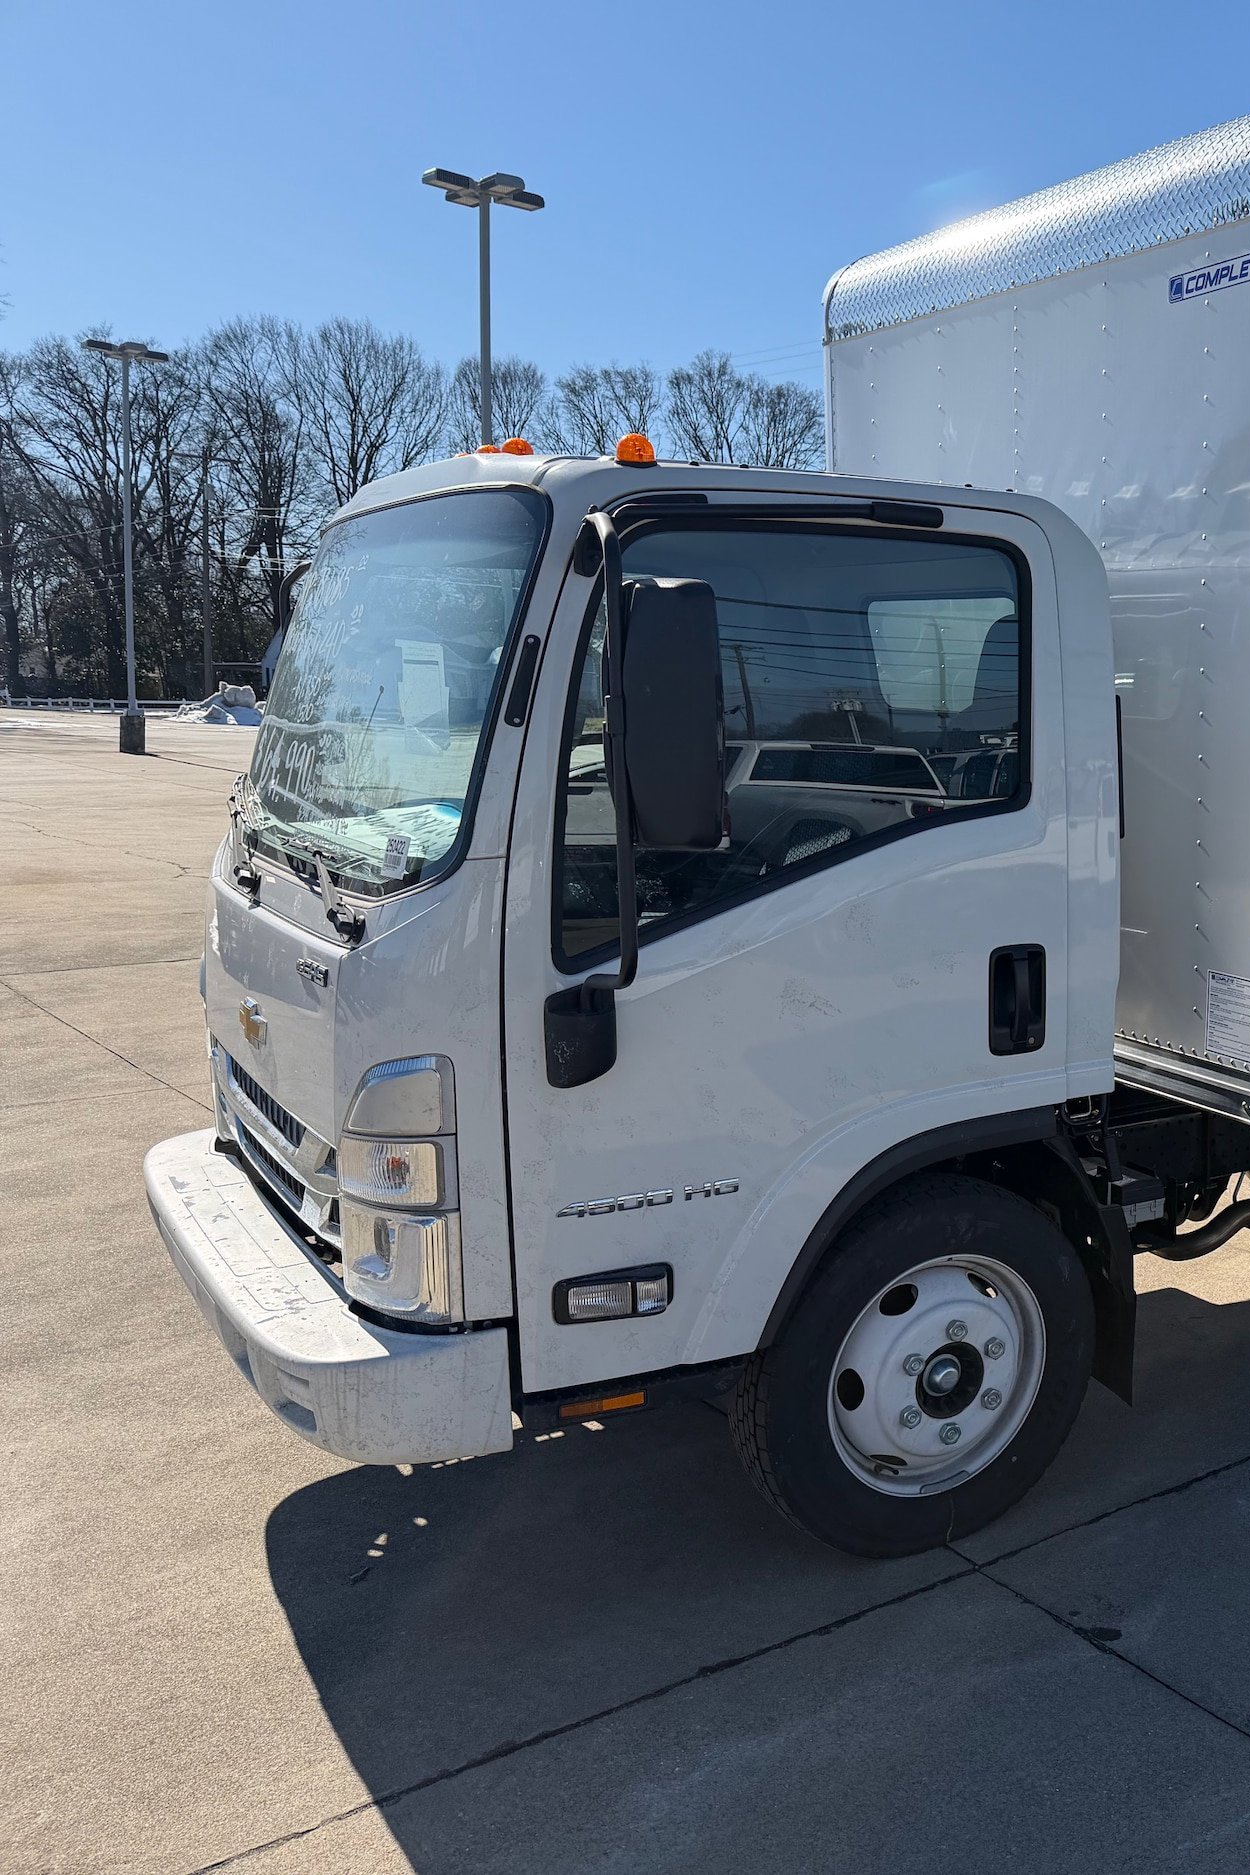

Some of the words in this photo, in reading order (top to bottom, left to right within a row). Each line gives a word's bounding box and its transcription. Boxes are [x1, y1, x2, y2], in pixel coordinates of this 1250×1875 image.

[385, 838, 406, 855] 250422
[556, 1187, 674, 1218] 4500
[684, 1176, 740, 1201] HG
